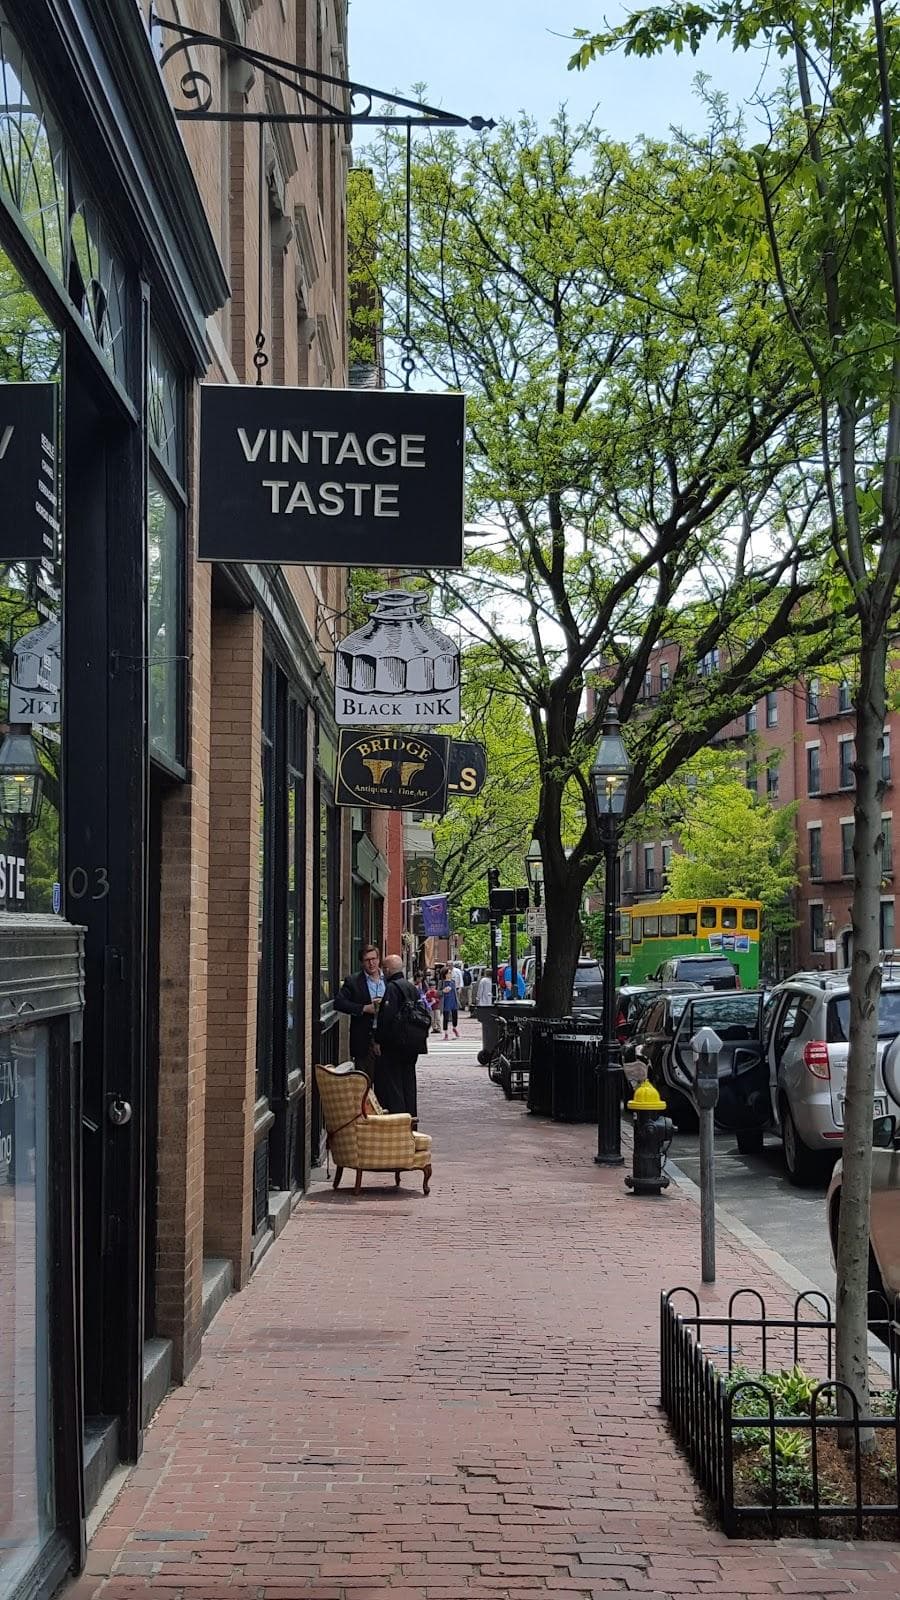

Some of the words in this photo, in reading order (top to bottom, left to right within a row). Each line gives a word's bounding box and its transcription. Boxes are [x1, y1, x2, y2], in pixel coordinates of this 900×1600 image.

[237, 427, 427, 468] VINTAGE
[262, 479, 400, 518] TASTE
[356, 738, 432, 762] BRIDGE
